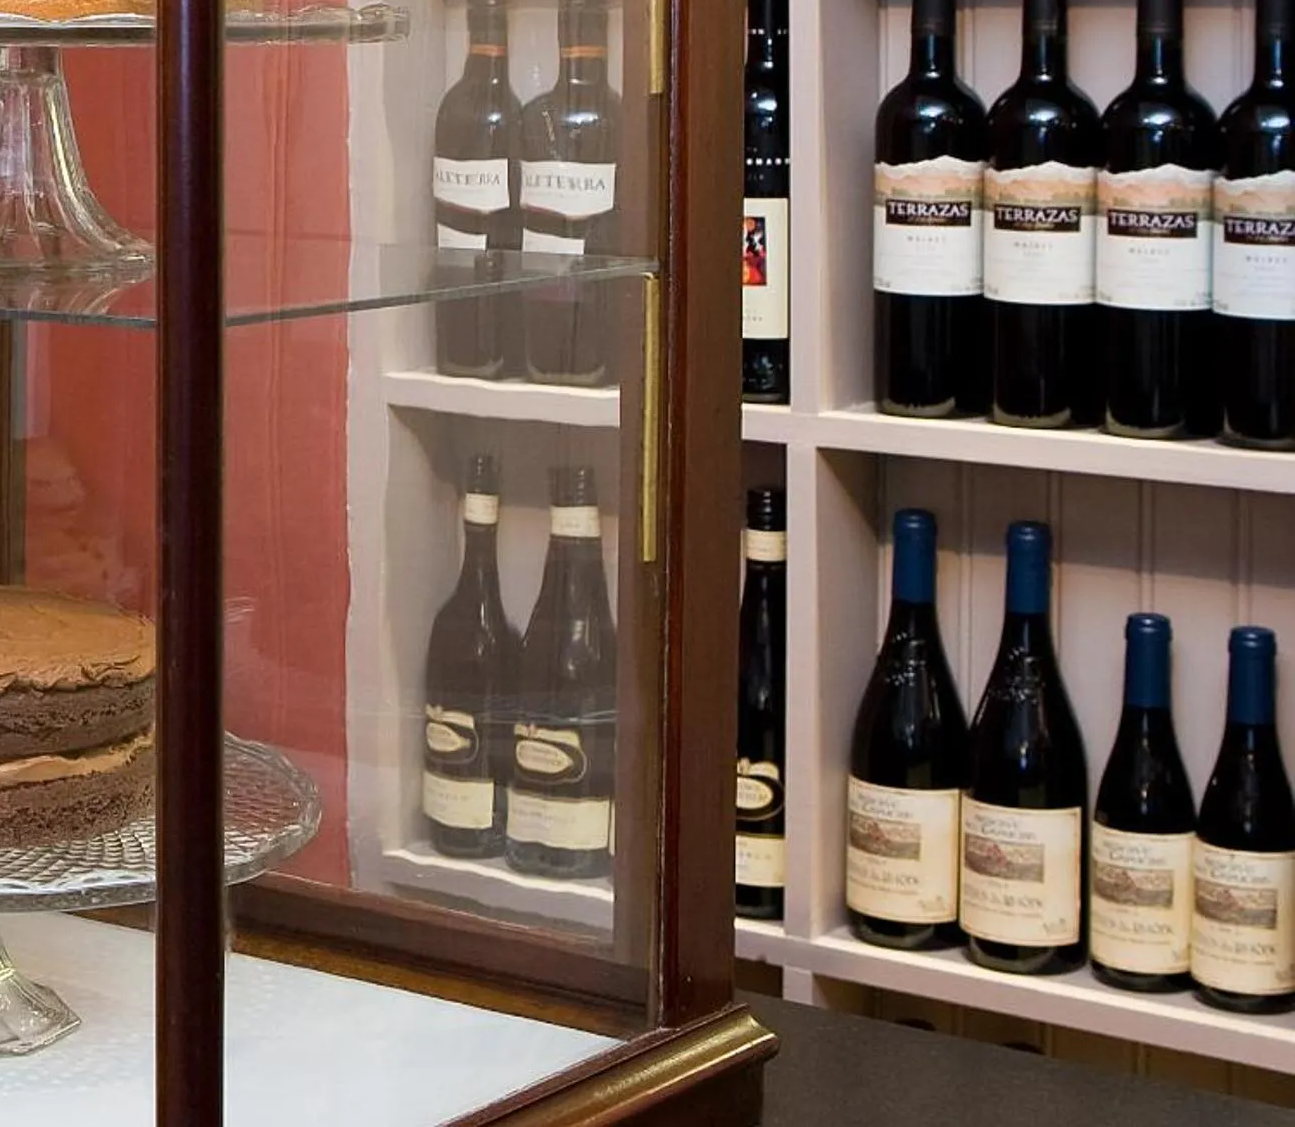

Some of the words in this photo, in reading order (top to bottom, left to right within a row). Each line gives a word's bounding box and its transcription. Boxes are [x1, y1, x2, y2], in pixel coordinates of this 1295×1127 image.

[887, 201, 969, 218] TERRAZAS
[996, 206, 1079, 224] TERRAZAS
[1110, 211, 1194, 229] TERRAZAS
